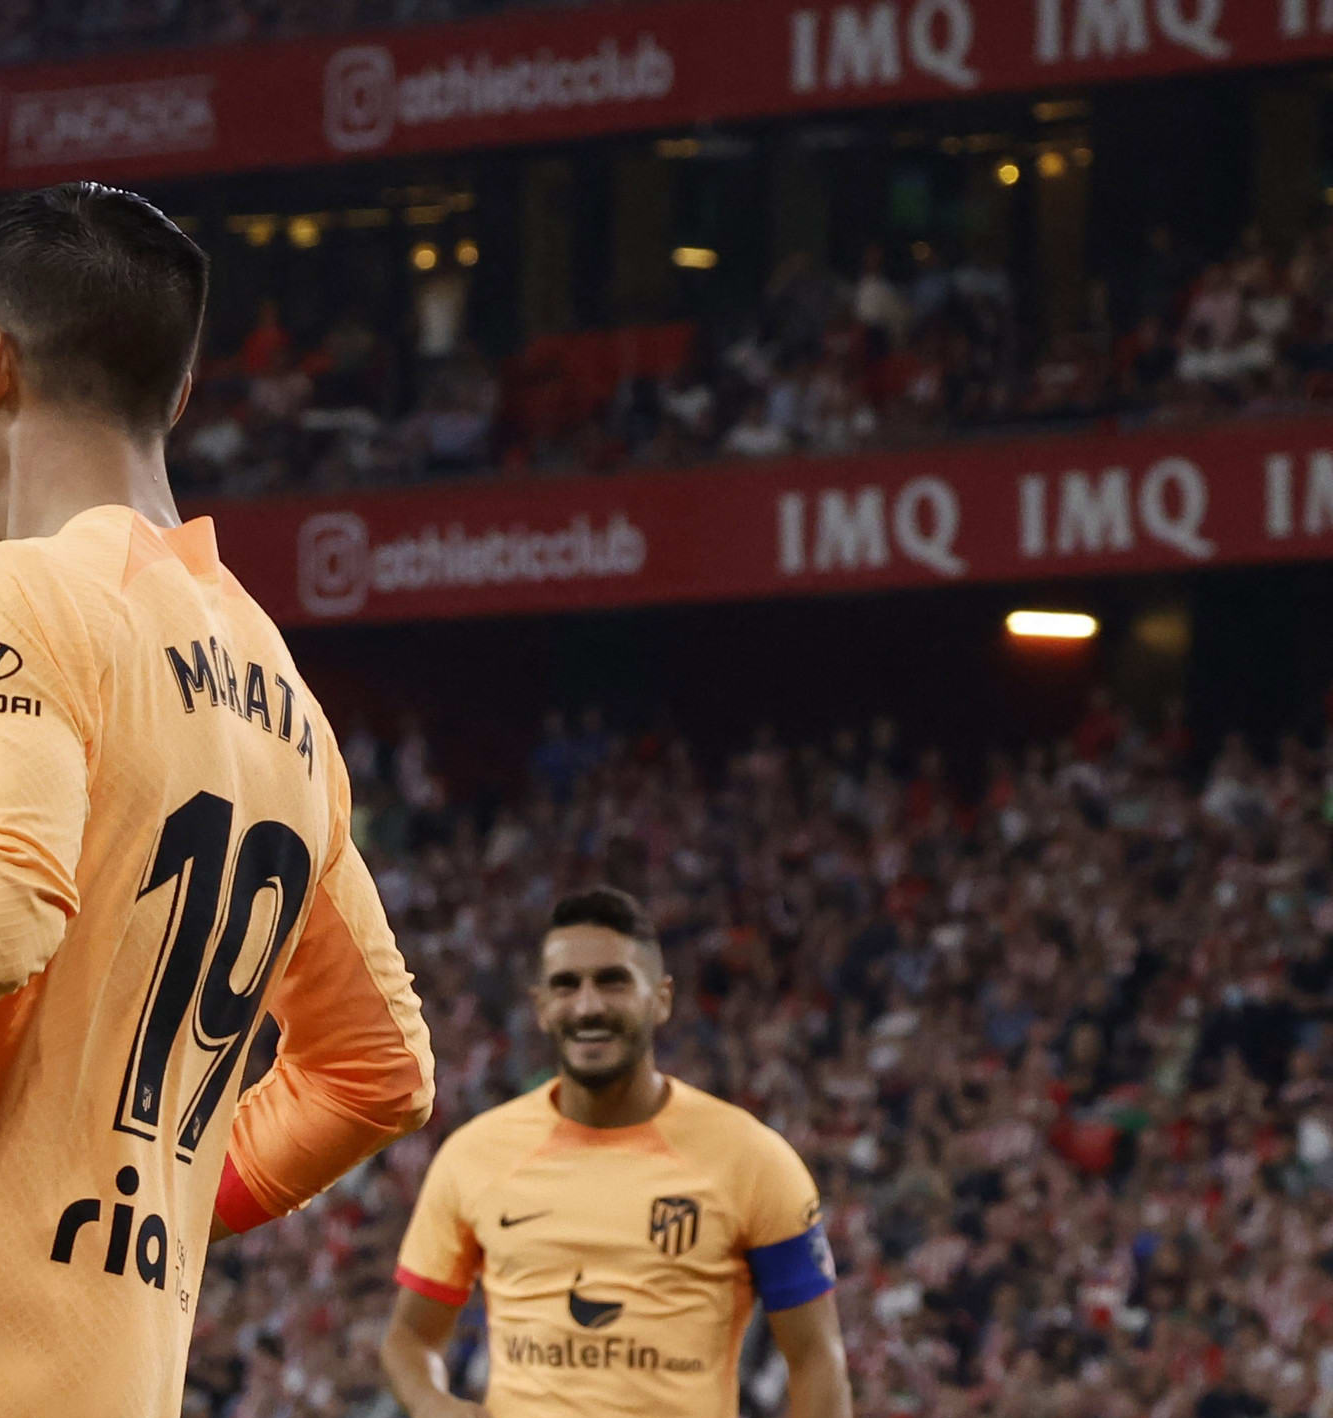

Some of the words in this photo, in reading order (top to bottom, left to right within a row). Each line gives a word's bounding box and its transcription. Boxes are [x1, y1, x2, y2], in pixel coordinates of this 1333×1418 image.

[790, 0, 978, 93] IMQ
[778, 475, 965, 577] IMQ
[1018, 457, 1216, 559] IMQ
[164, 635, 313, 781] MORATA
[113, 789, 311, 1165] 19
[50, 1165, 167, 1290] ria
